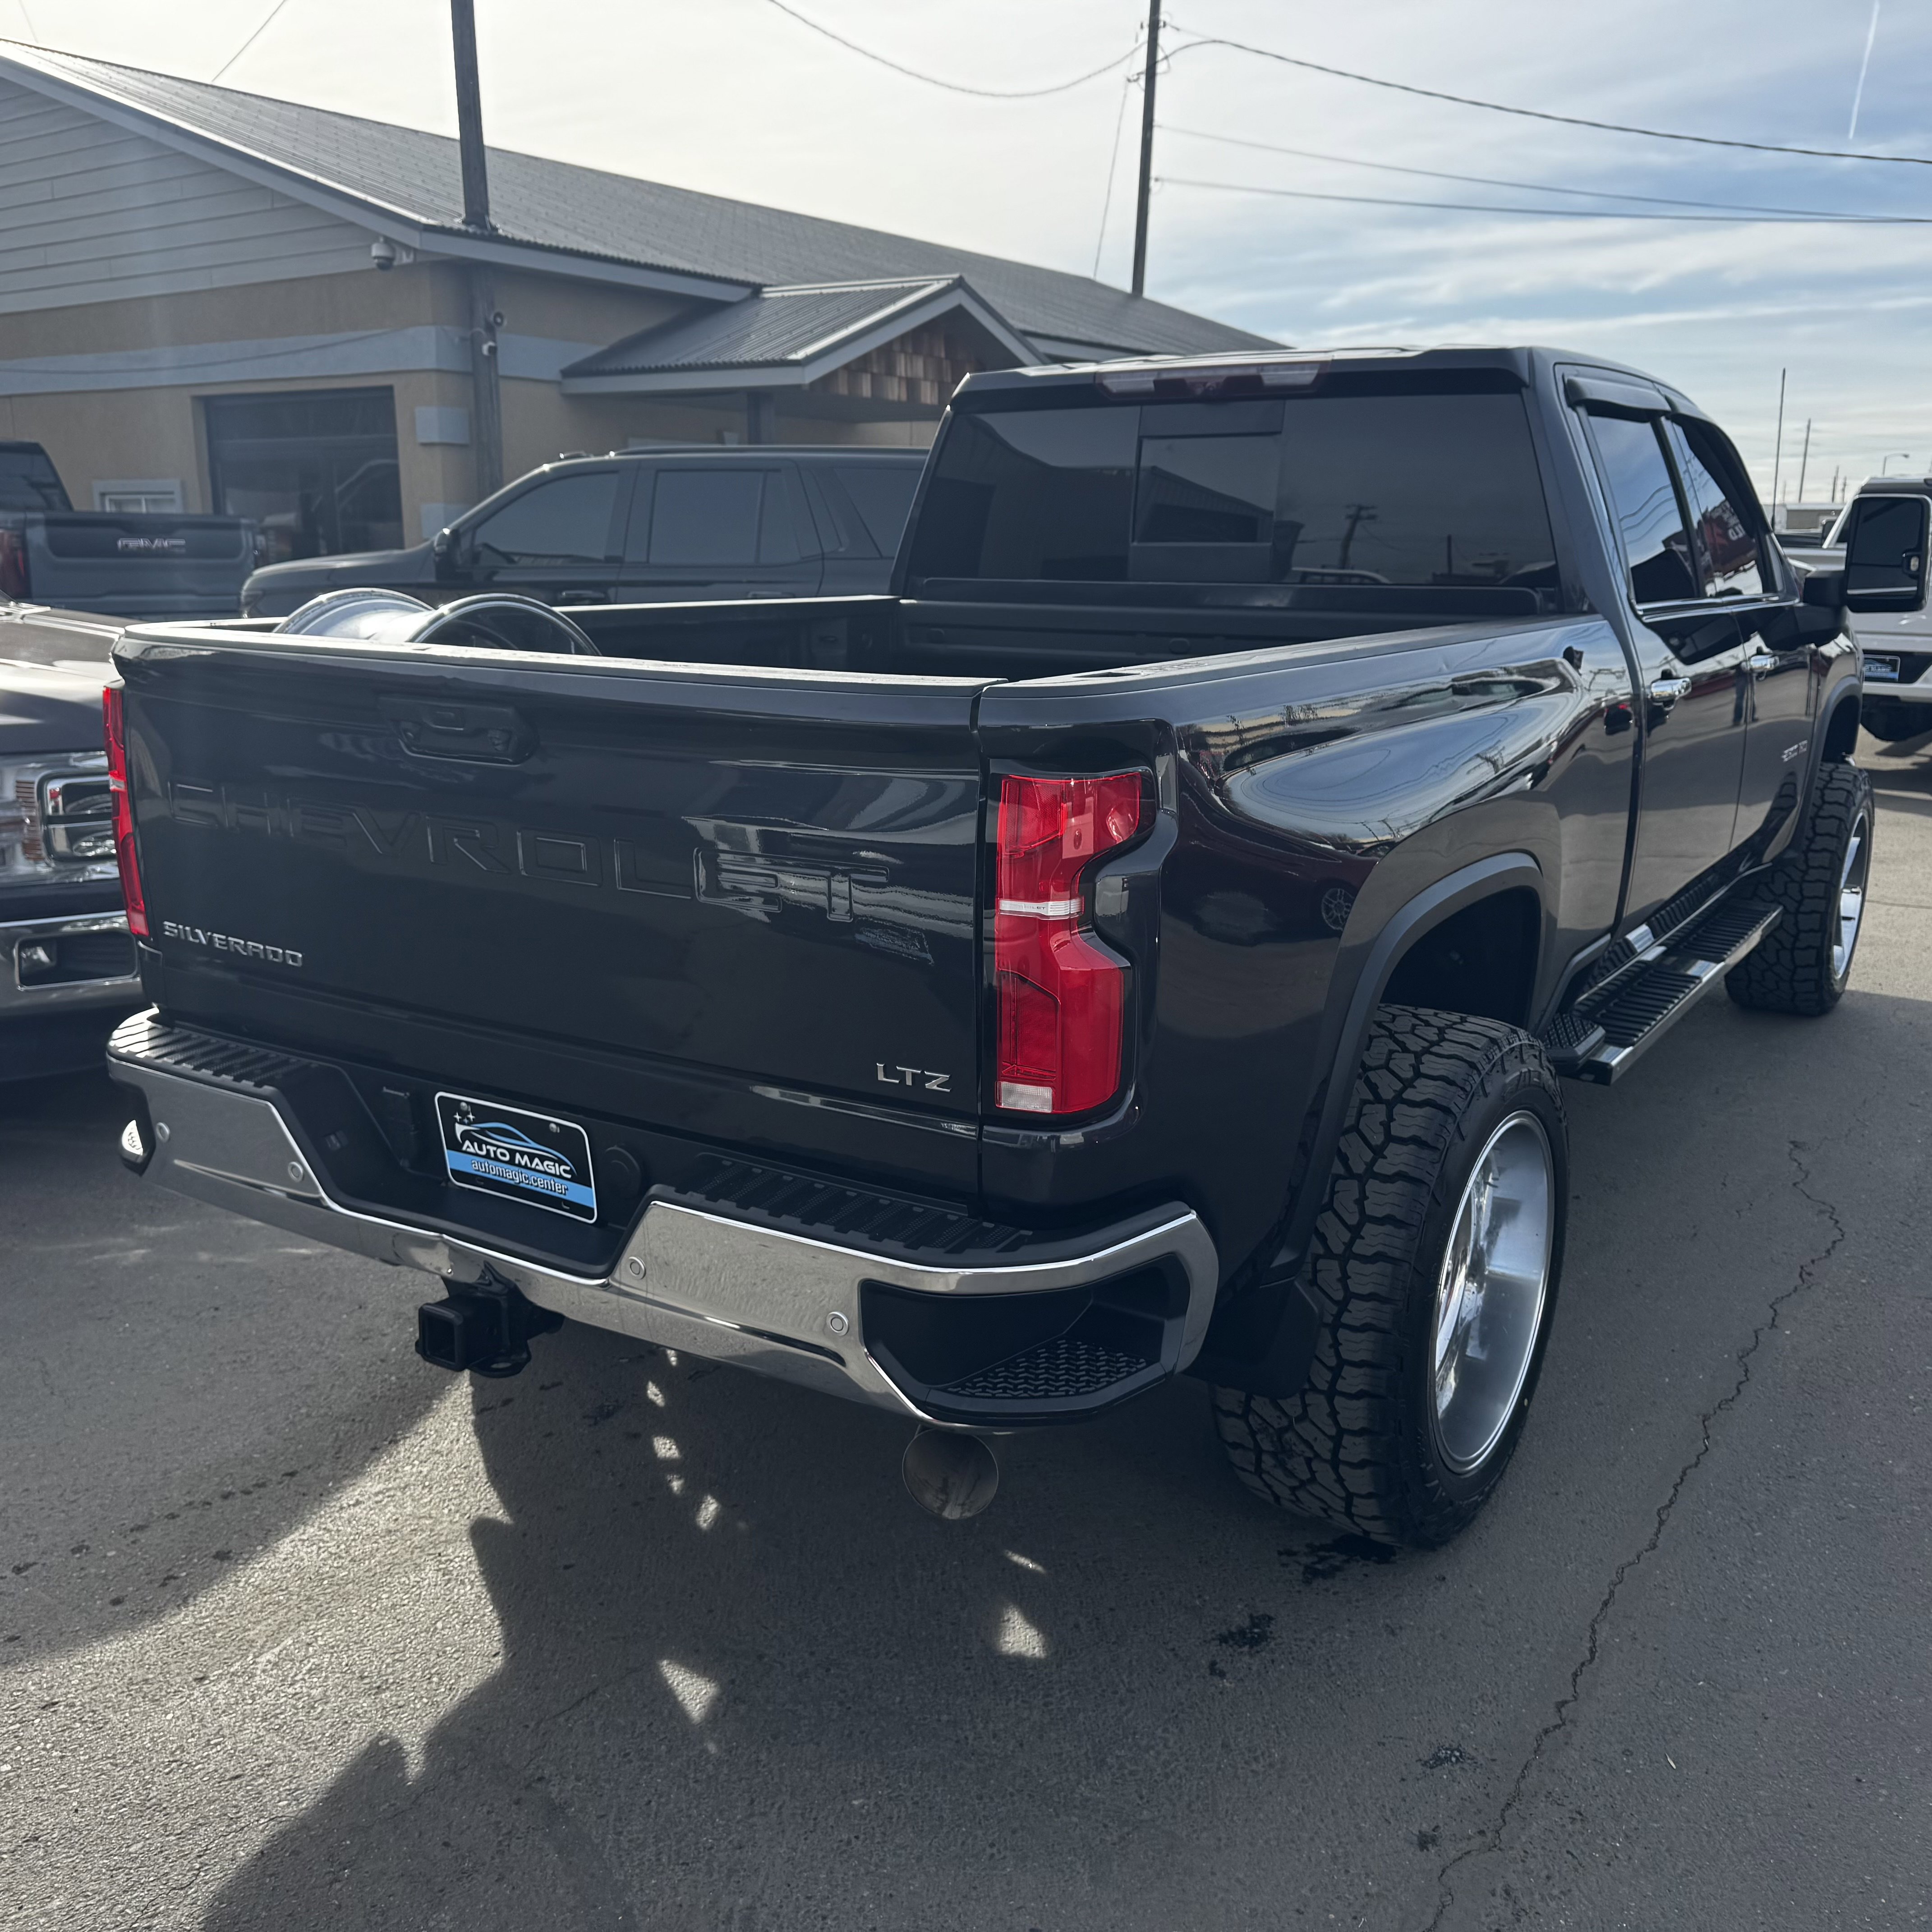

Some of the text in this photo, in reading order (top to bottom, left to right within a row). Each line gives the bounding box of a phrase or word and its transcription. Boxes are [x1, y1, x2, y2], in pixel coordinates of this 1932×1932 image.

[117, 538, 185, 553] GMC
[163, 920, 303, 967] SILVERADO
[876, 1063, 952, 1092] LTZ
[462, 1140, 572, 1179] AUTO MAGIC
[472, 1159, 568, 1195] automagic.center
